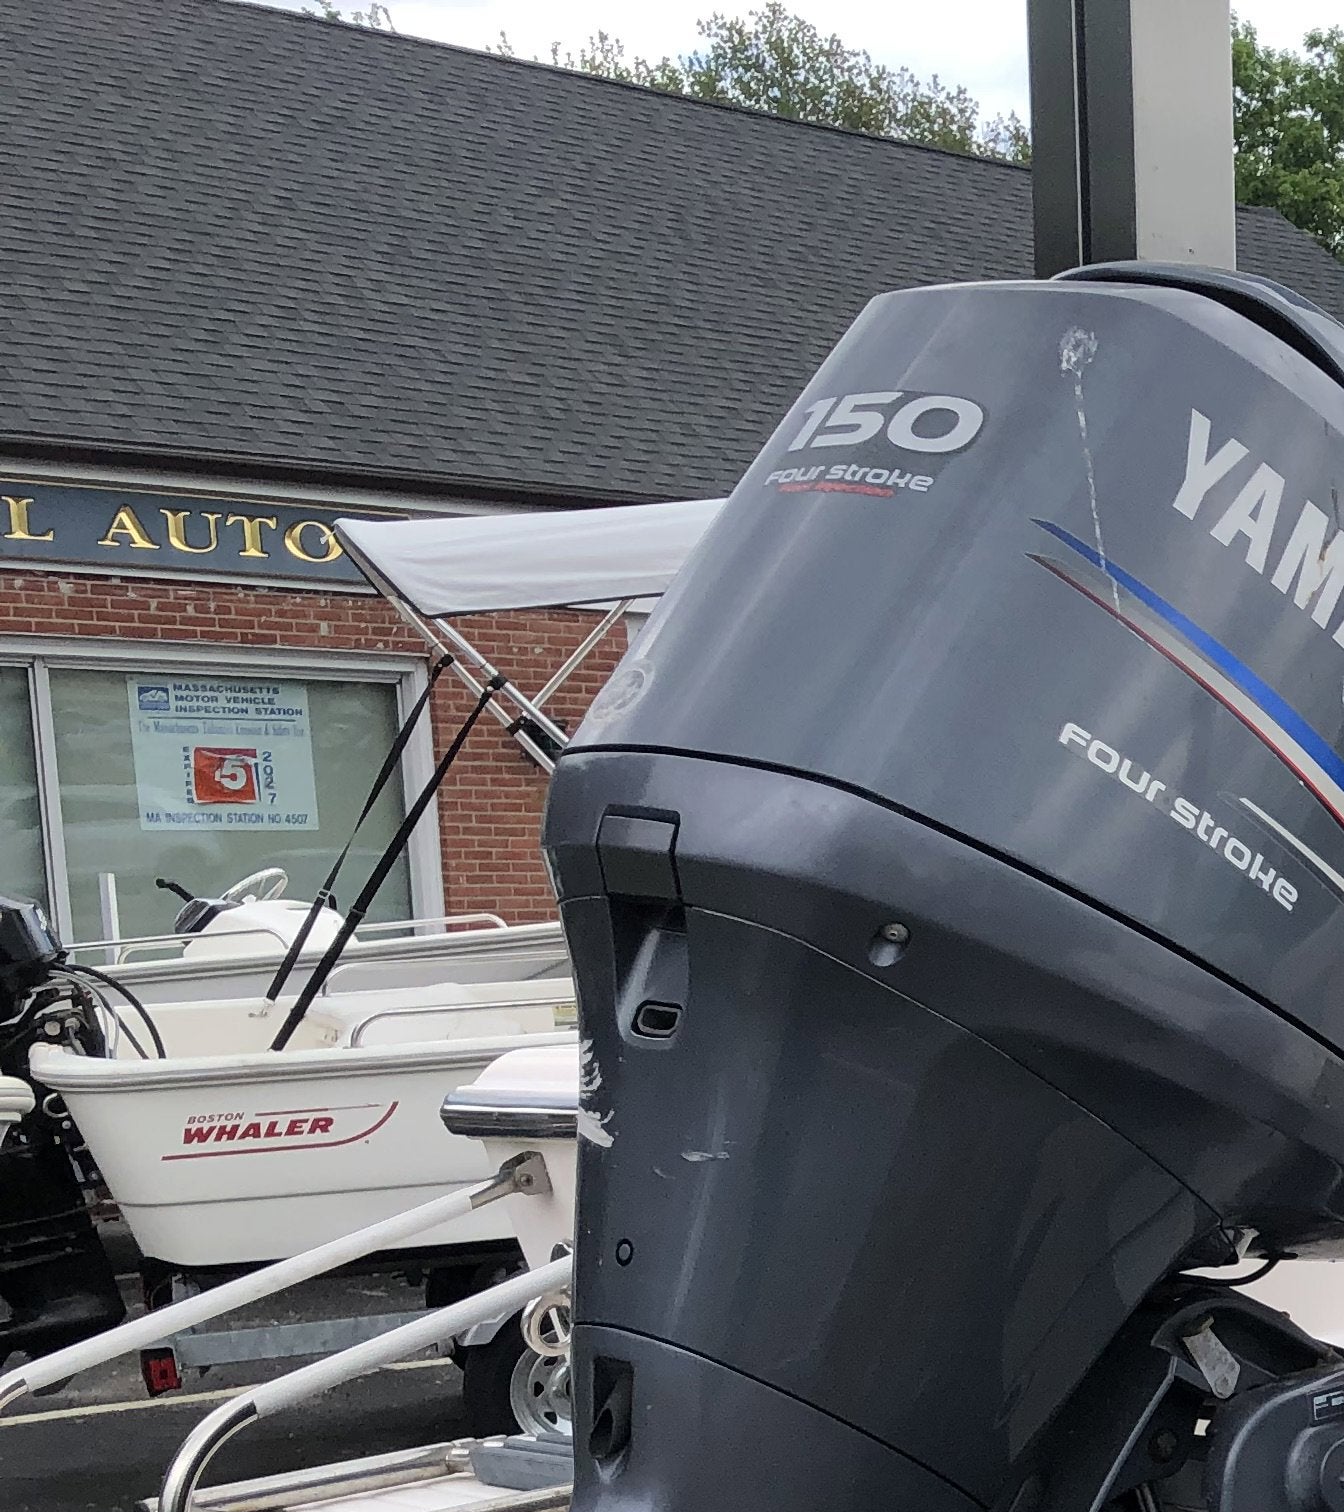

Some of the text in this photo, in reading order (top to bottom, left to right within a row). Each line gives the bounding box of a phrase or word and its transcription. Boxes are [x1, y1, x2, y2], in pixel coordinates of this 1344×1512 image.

[787, 391, 984, 453] 150
[97, 503, 347, 564] AUTO
[173, 683, 280, 695] MASSACHUSETTS
[175, 694, 276, 706] MOTOR VEHICLE
[175, 705, 303, 717] INSPECTION STATION
[214, 757, 247, 791] 5
[262, 751, 277, 805] 2027
[165, 812, 222, 824] INSPECTION
[227, 813, 263, 824] STATION
[187, 1111, 245, 1125] BOSTON
[183, 1116, 335, 1145] WHALER
